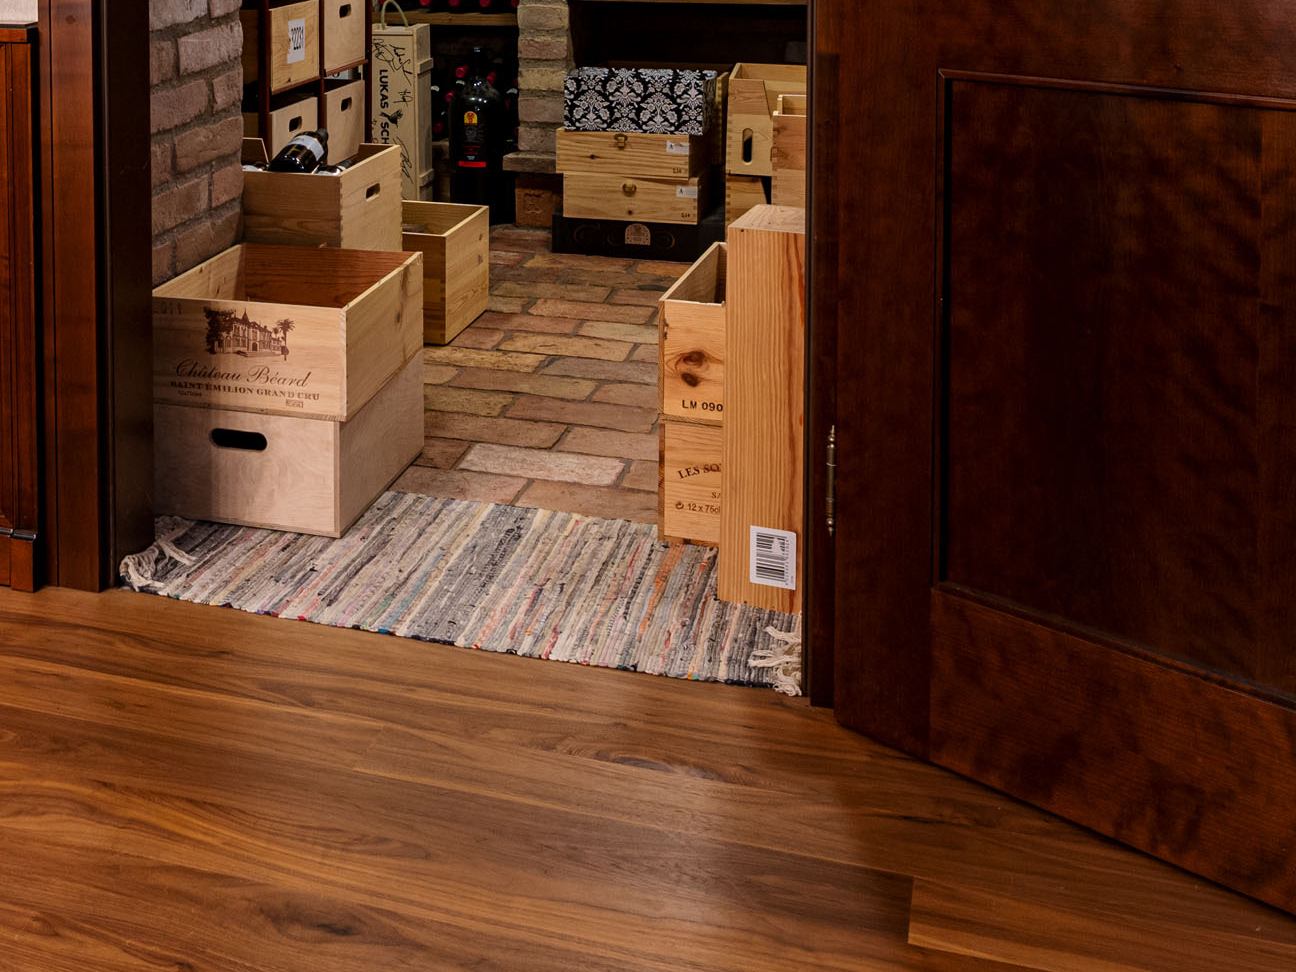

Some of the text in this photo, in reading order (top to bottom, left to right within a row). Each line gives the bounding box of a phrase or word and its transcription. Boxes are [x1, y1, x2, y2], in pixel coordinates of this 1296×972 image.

[379, 69, 389, 109] LUKAS
[176, 358, 312, 387] Château Béard
[256, 388, 295, 399] GRAND
[297, 391, 320, 401] CRU
[681, 399, 724, 412] LM 090
[677, 462, 722, 479] LES SO
